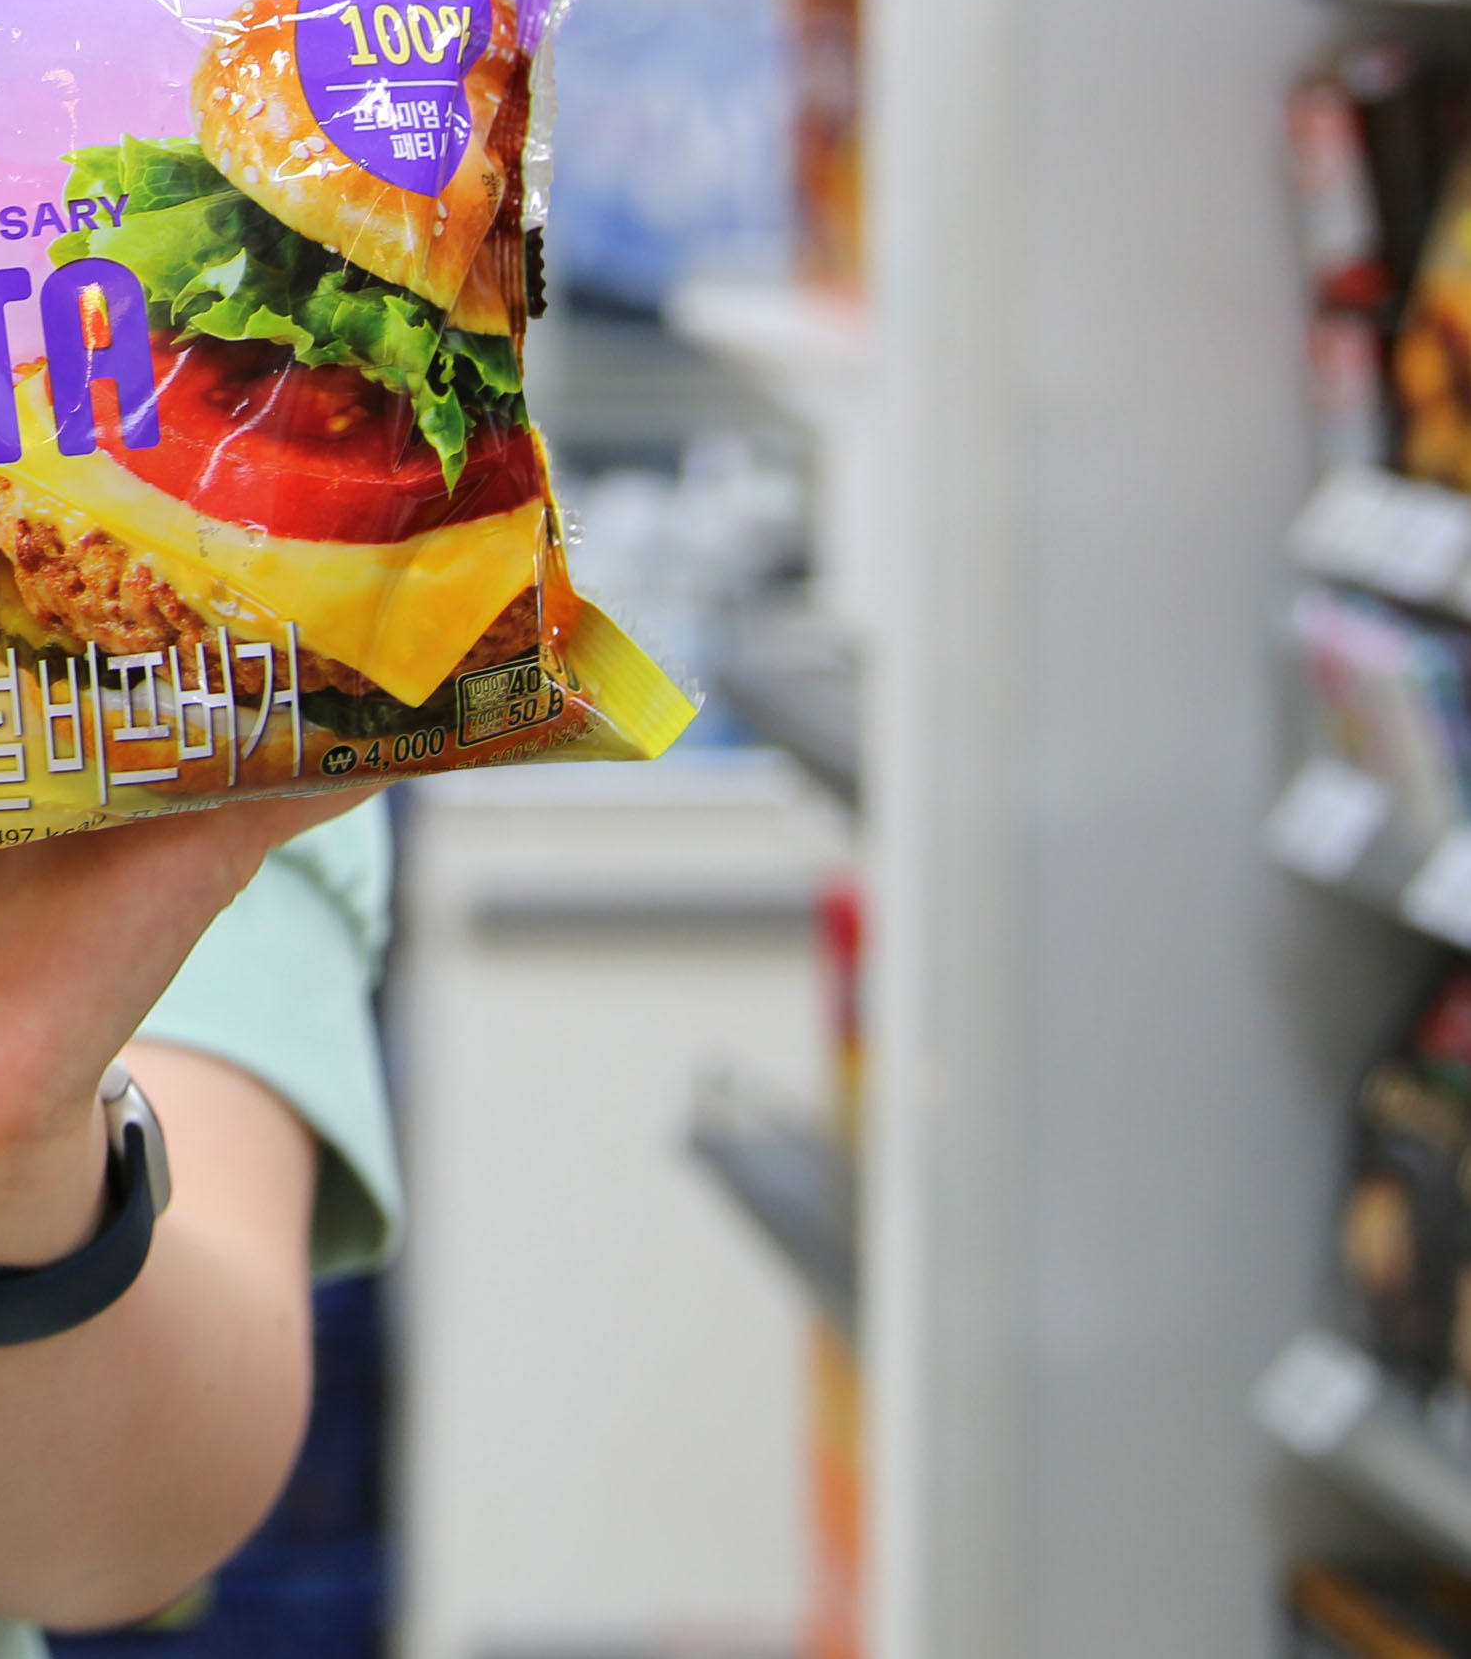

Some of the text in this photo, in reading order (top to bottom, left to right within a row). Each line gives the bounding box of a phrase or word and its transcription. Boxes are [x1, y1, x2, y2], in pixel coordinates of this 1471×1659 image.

[389, 131, 437, 160] 패티
[509, 665, 541, 698] 40
[39, 621, 302, 806] 비프버거
[507, 698, 538, 727] 50
[363, 728, 445, 771] 4,000
